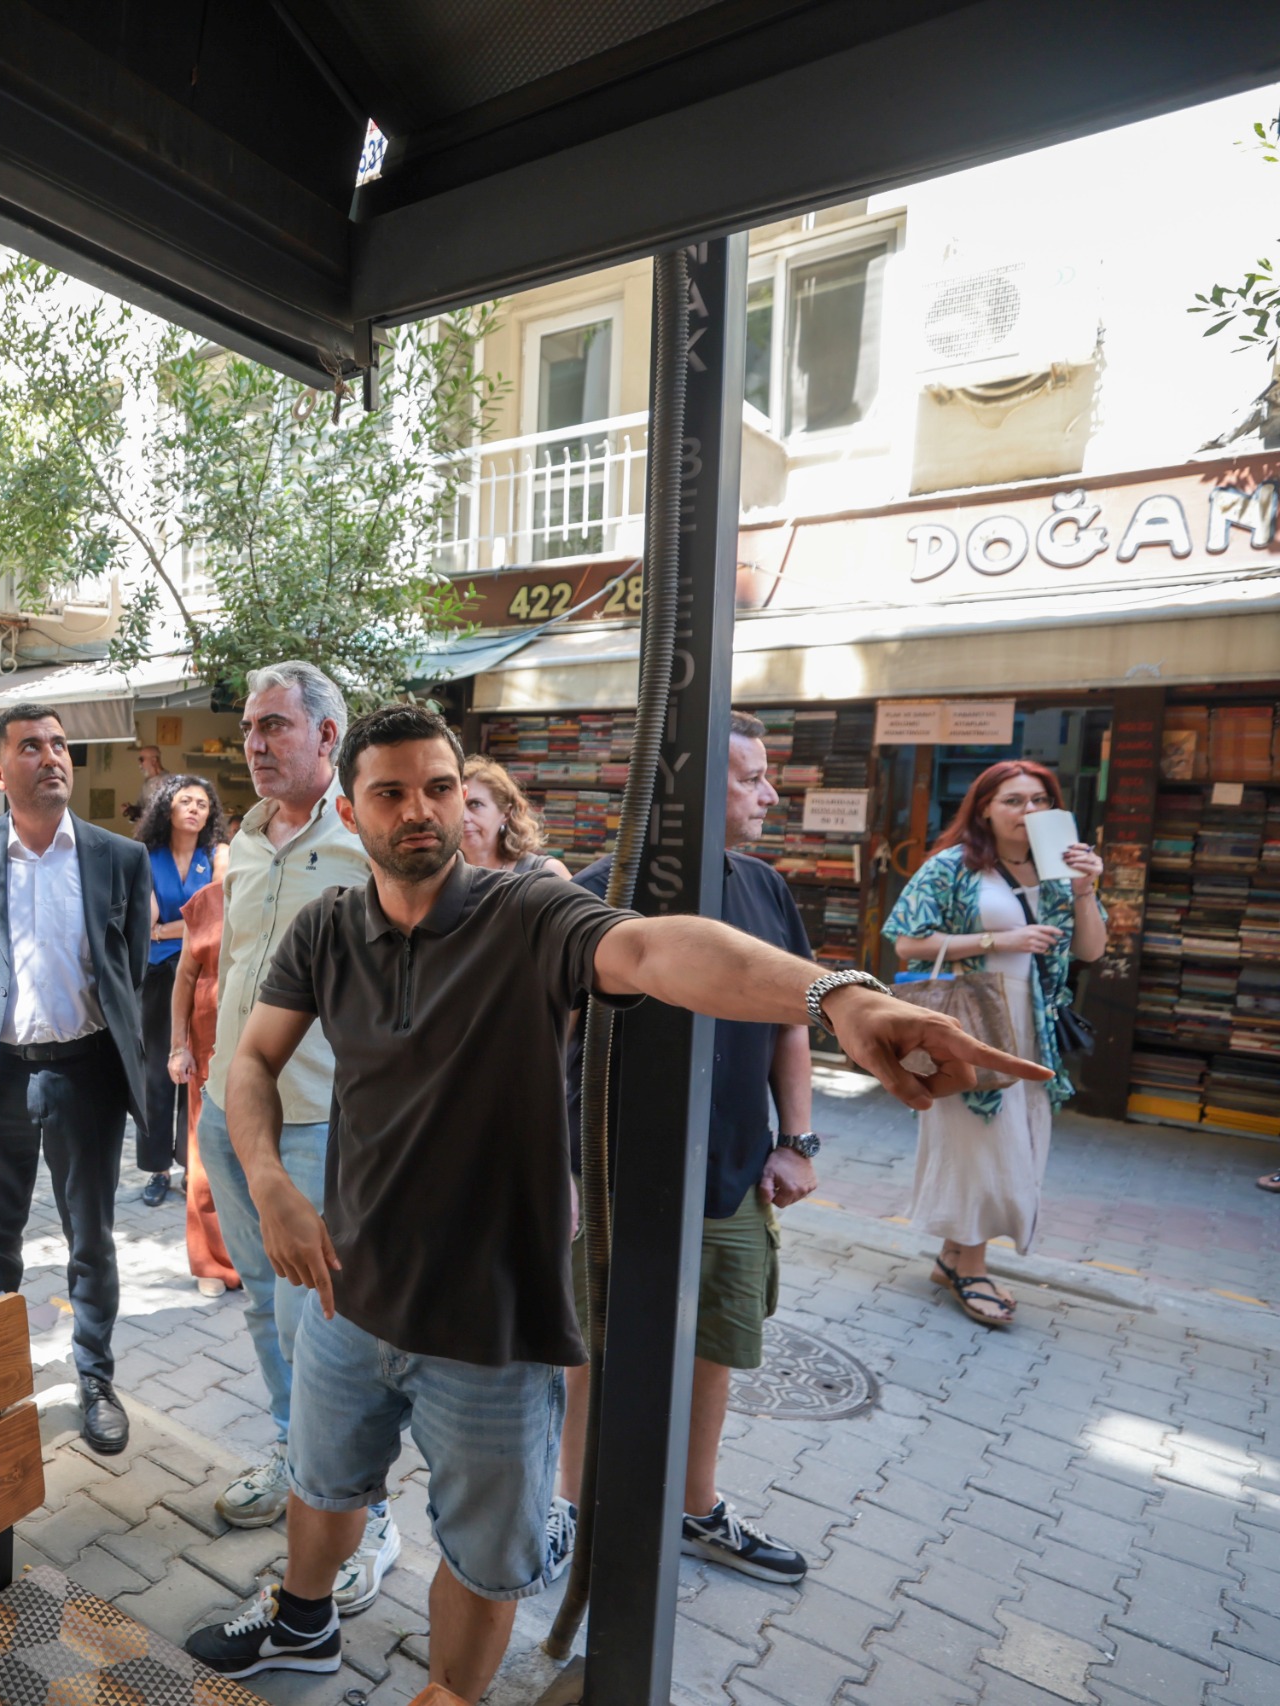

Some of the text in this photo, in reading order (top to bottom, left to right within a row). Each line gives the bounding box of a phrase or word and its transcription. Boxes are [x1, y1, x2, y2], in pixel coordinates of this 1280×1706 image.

[907, 479, 1278, 583] DOĞAN
[509, 583, 572, 619] 422
[646, 437, 703, 911] BEEDİYES
